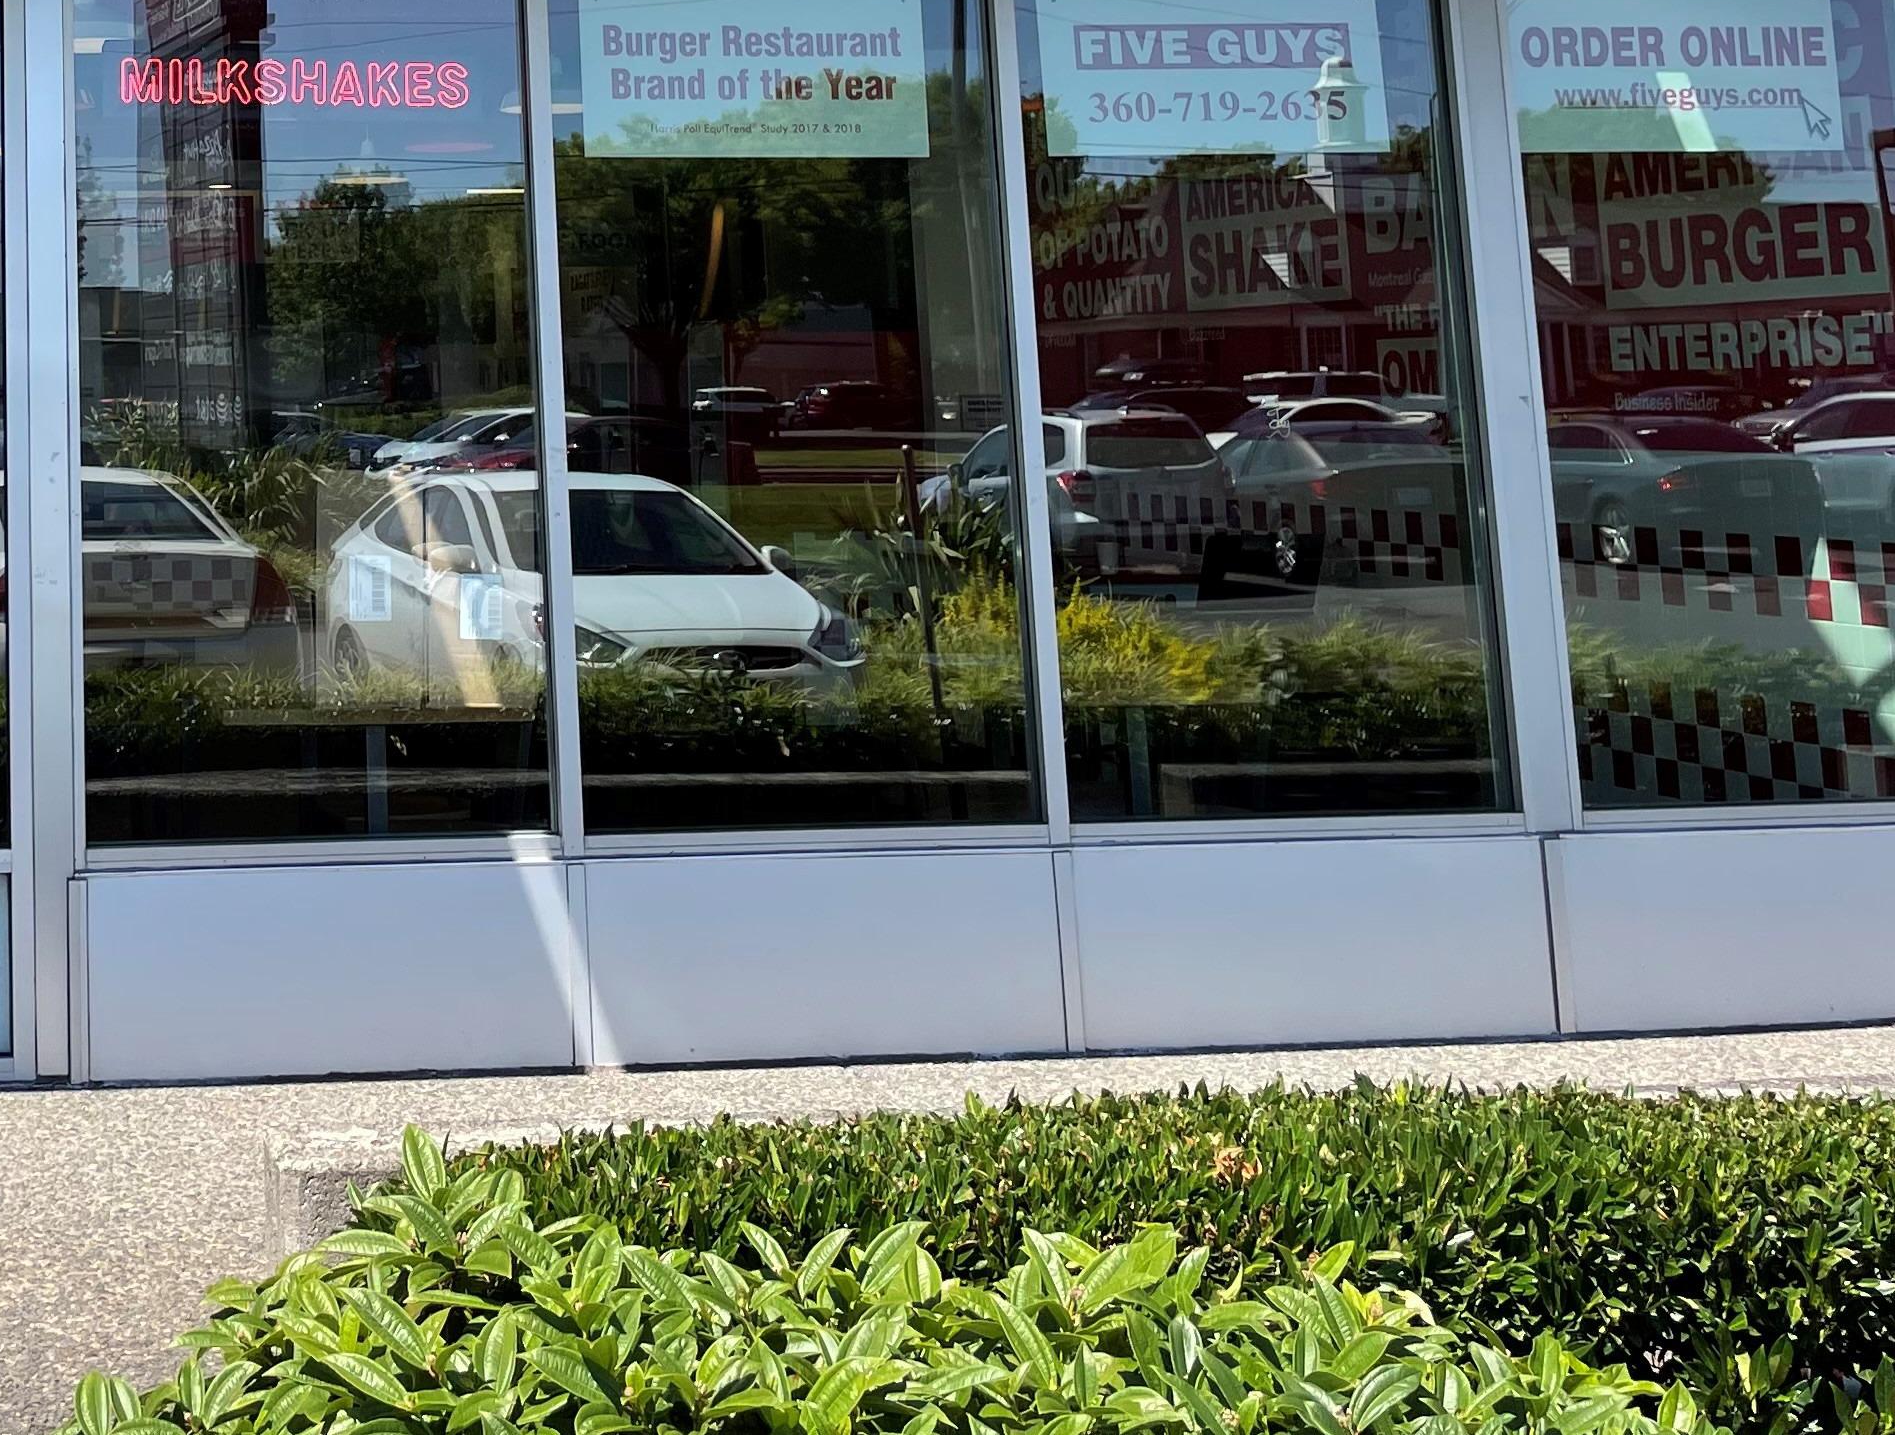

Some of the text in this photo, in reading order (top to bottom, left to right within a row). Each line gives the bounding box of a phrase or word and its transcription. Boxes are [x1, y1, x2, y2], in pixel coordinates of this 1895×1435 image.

[603, 24, 902, 64] Burger Restaurant
[1078, 27, 1346, 66] FIVE GUYS
[1520, 26, 1665, 67] ORDER
[1679, 25, 1827, 67] ONLINE
[119, 57, 469, 108] MILKSHAKES
[611, 68, 897, 101] Brand of the Year
[1554, 82, 1803, 111] www.fiveguys.com
[1088, 90, 1348, 123] 360-719-2635
[1187, 165, 1328, 222] AMERICA
[1076, 214, 1169, 265] POTATO
[1189, 218, 1343, 298] SHAKE
[1606, 201, 1878, 291] BURGER
[1043, 272, 1171, 320] & QUANTITY
[1614, 391, 1721, 412] Business Insider
